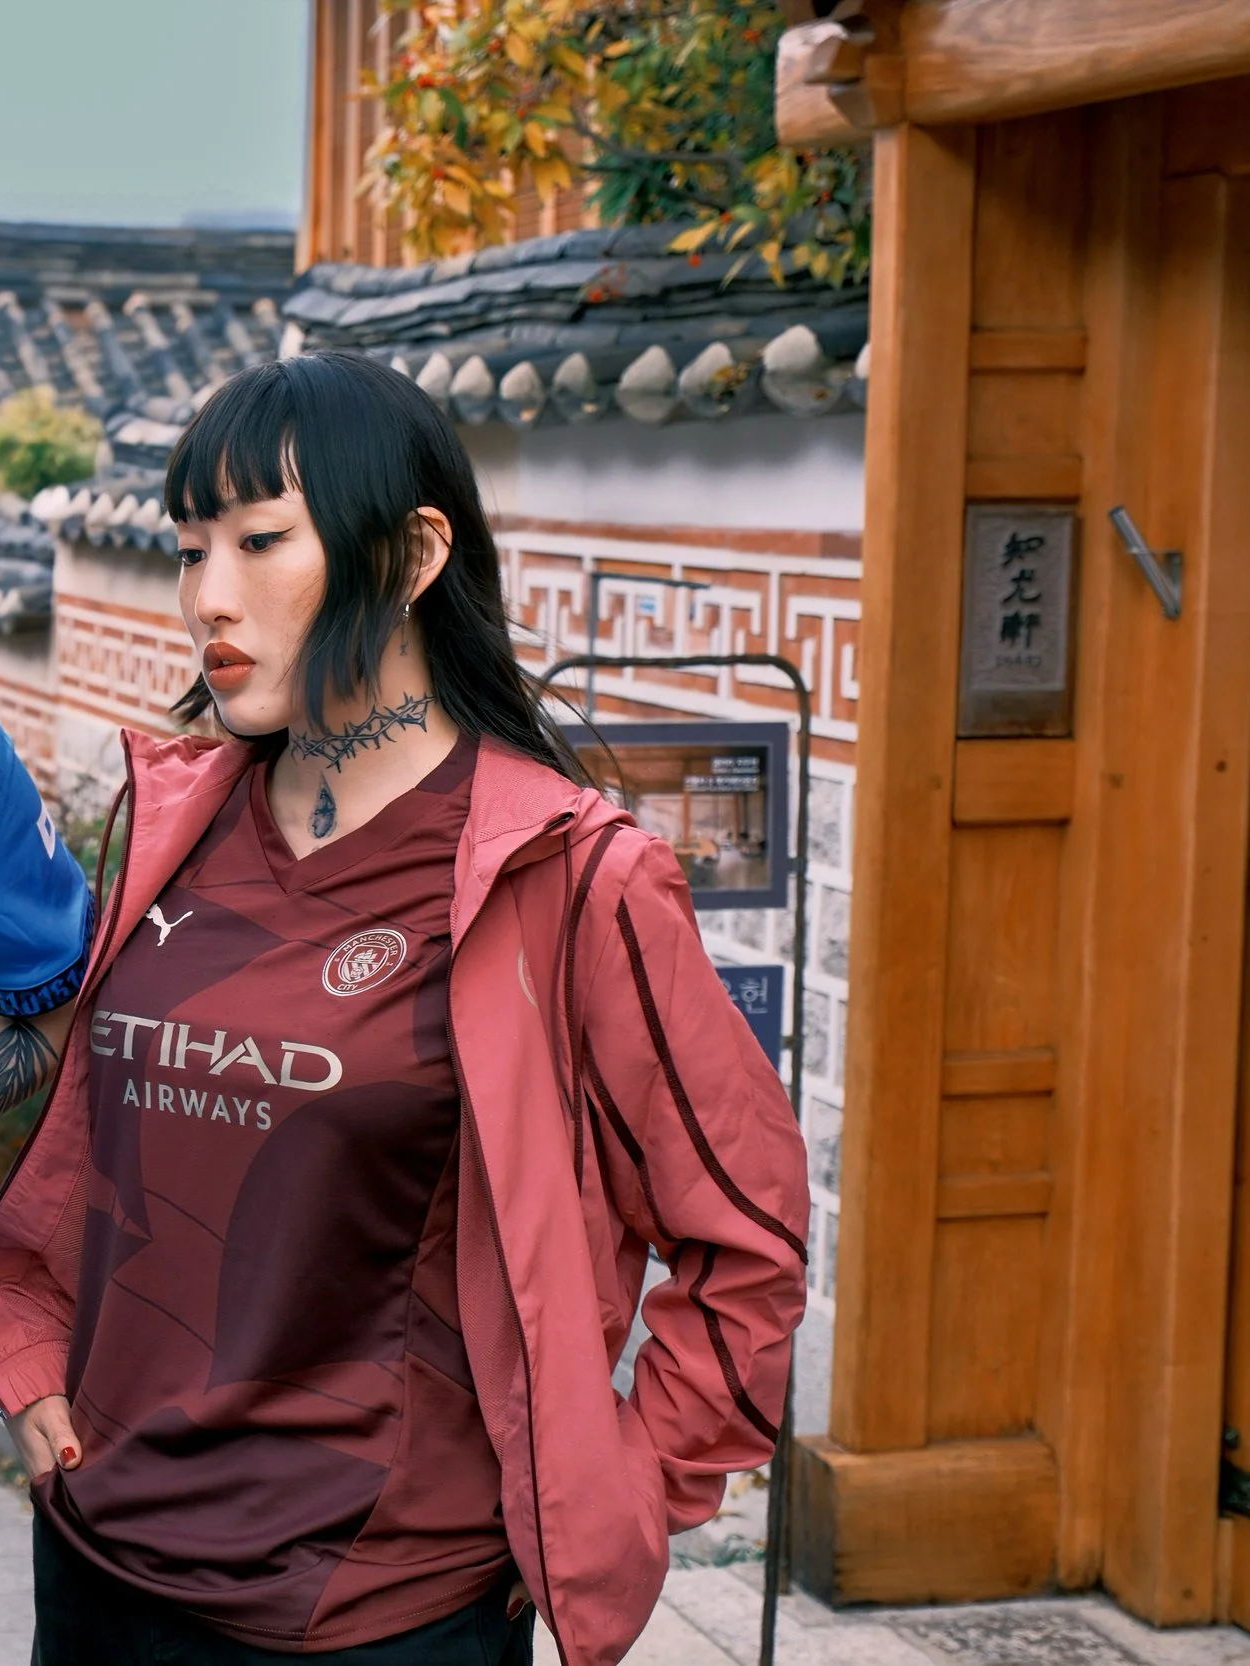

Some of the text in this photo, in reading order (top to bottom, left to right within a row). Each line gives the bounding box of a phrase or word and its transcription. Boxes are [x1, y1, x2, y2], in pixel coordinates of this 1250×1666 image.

[343, 934, 398, 957] MANCHESTER
[337, 983, 359, 991] CITY
[89, 1010, 343, 1092] ETIHAD
[122, 1078, 272, 1131] AIRWAYS
